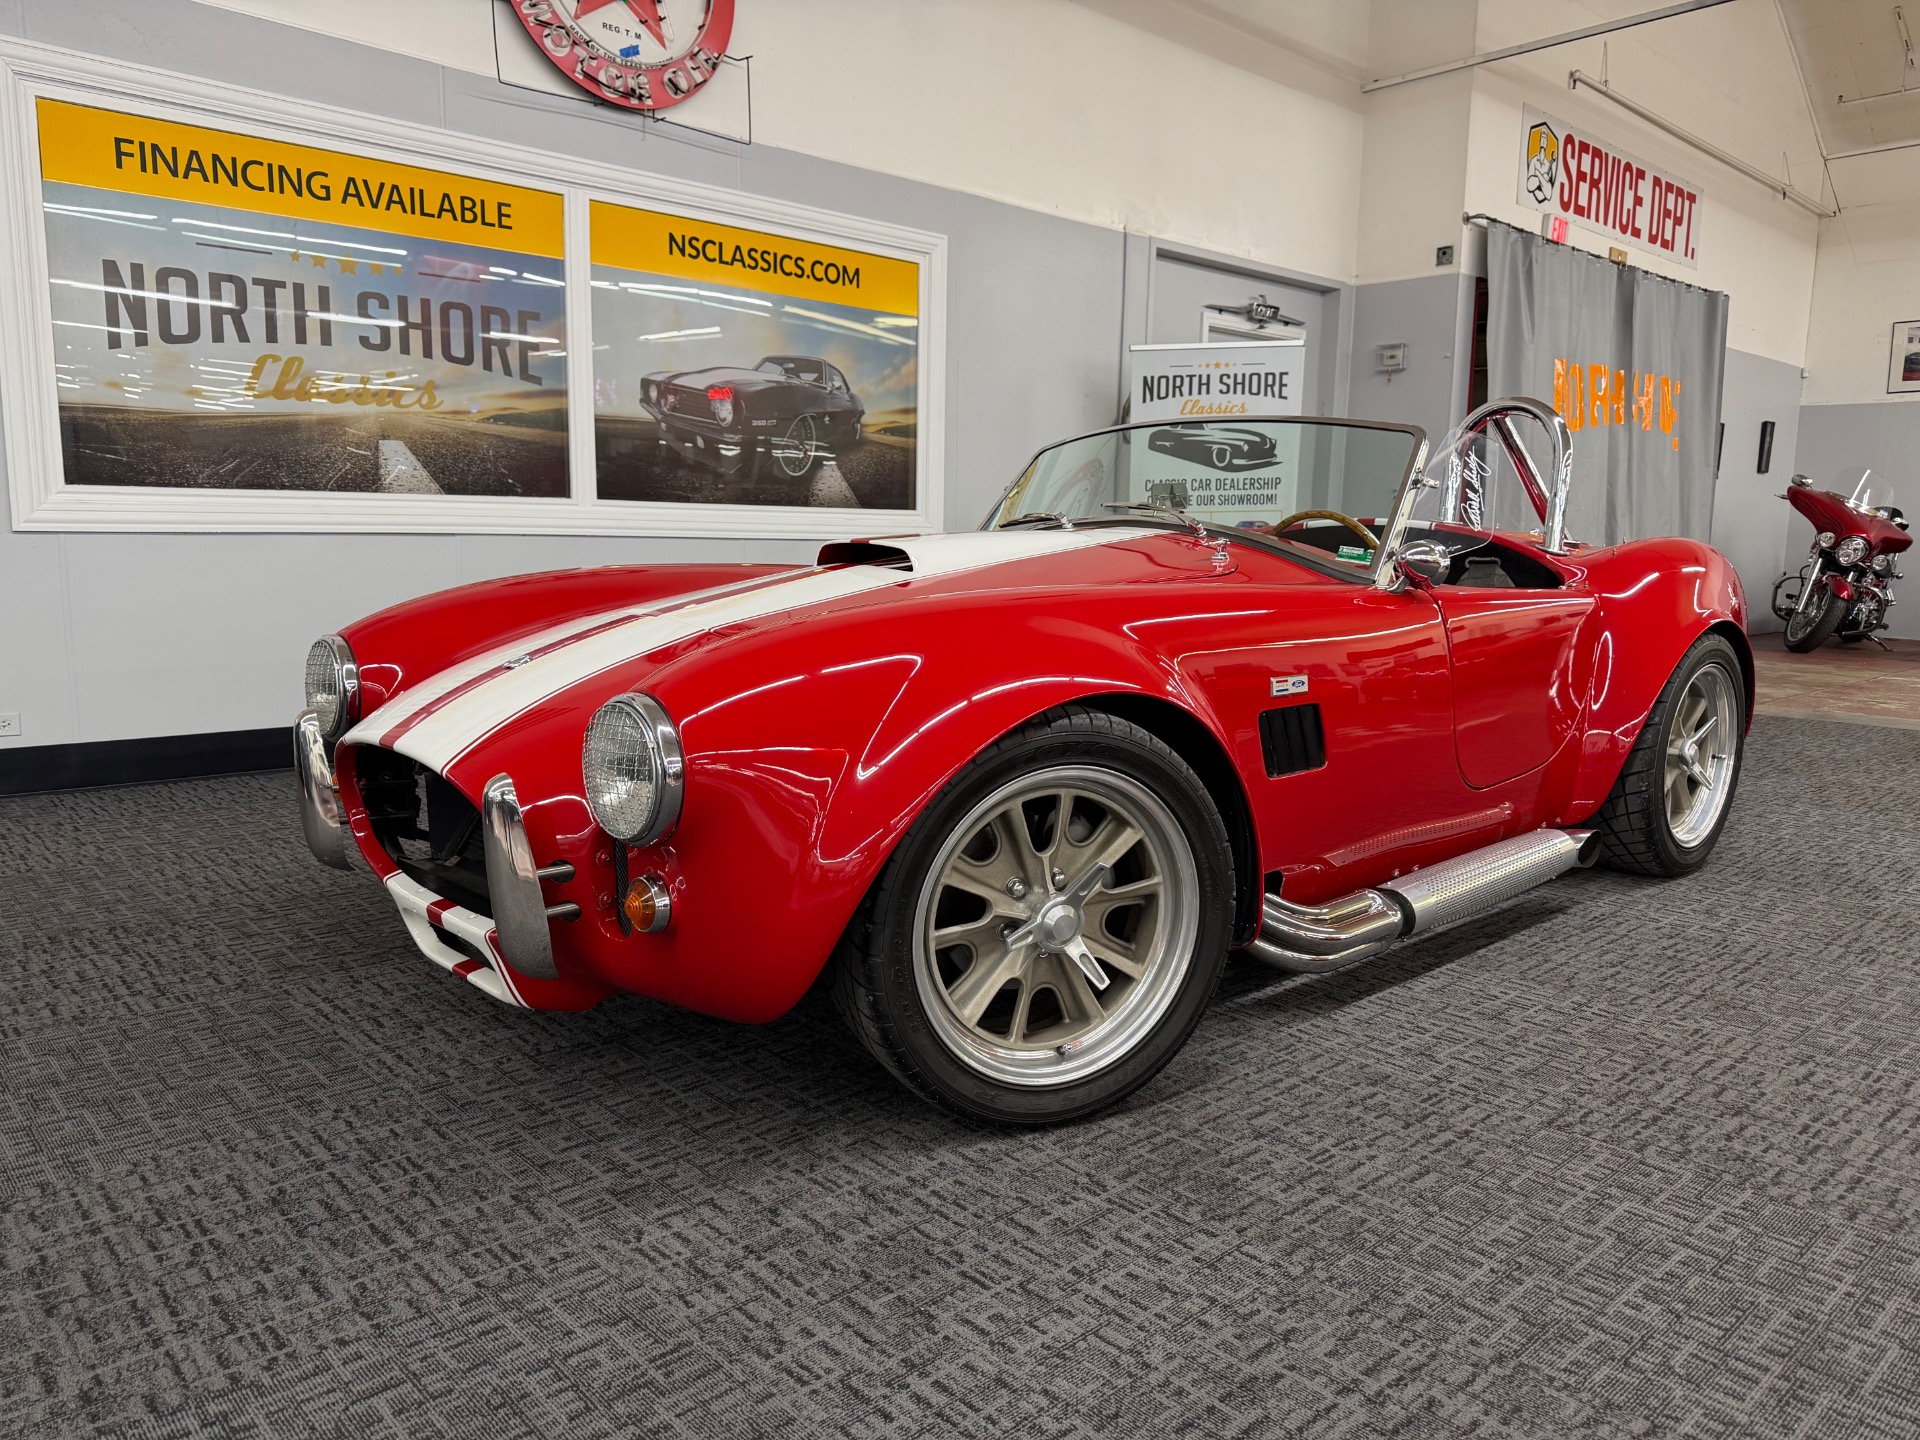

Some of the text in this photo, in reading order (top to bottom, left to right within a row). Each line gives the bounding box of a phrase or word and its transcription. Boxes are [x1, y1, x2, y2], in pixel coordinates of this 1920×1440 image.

[114, 136, 513, 230] FINANCING AVAILABLE
[1559, 133, 1697, 260] SERVICE DEPT.
[1551, 216, 1569, 244] EXIT
[669, 232, 861, 289] NSCLASSICS.COM
[102, 258, 543, 386] NORTH SHORE
[243, 353, 444, 411] Classics
[1142, 371, 1289, 404] NORTH SHORE
[1180, 399, 1249, 416] Classics
[1191, 478, 1212, 492] CAR
[1215, 477, 1282, 491] DEALERSHIP
[1196, 494, 1216, 506] OUR
[1217, 493, 1278, 506] SHOWROOM!
